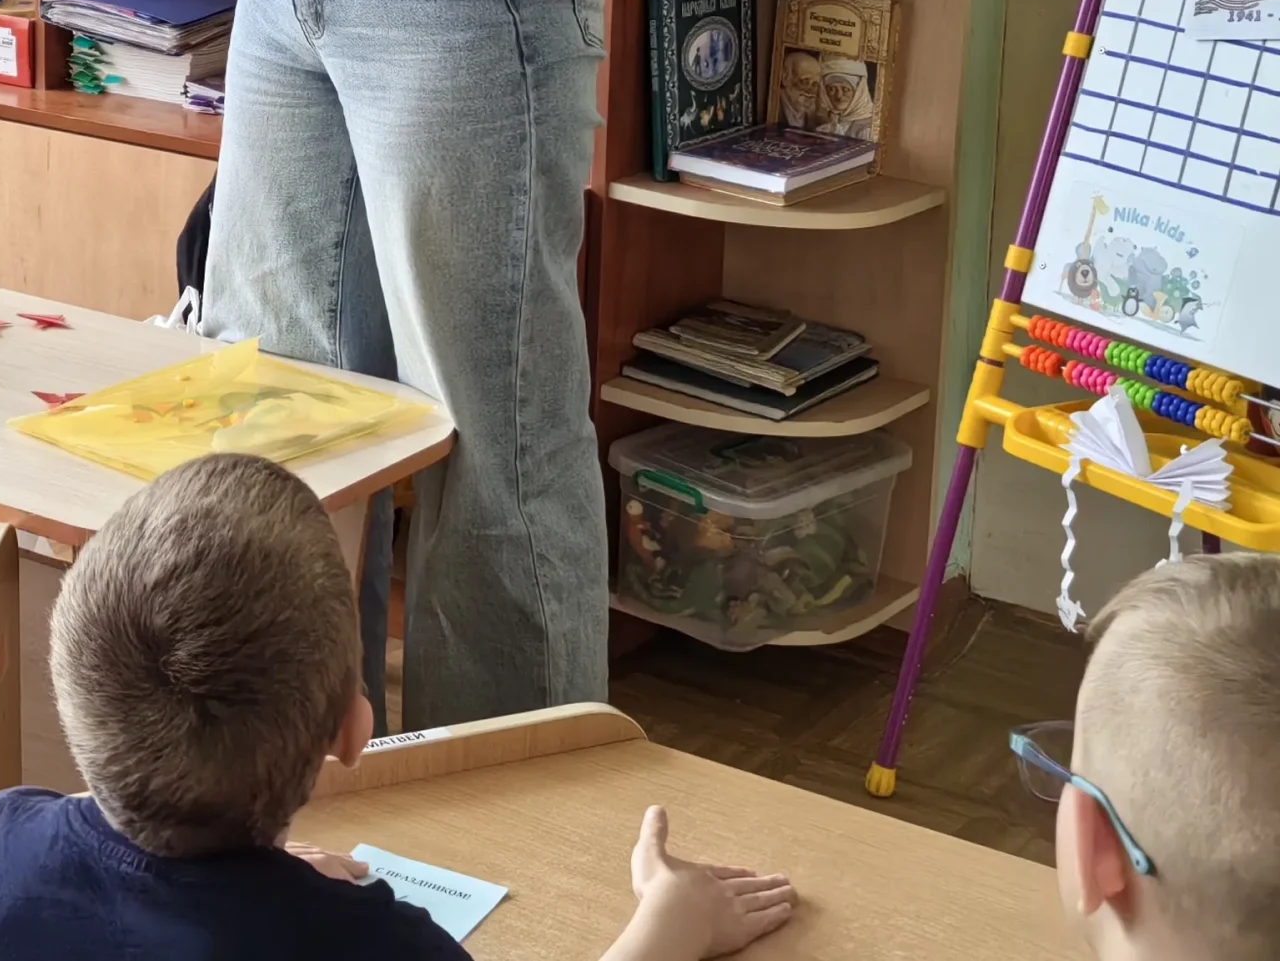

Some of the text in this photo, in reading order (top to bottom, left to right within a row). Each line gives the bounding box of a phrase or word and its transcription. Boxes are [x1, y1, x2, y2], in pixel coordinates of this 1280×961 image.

[1227, 10, 1262, 23] 1941
[1113, 207, 1186, 243] Nika kids
[384, 868, 472, 901] ПРАЗДНИКОМ!
